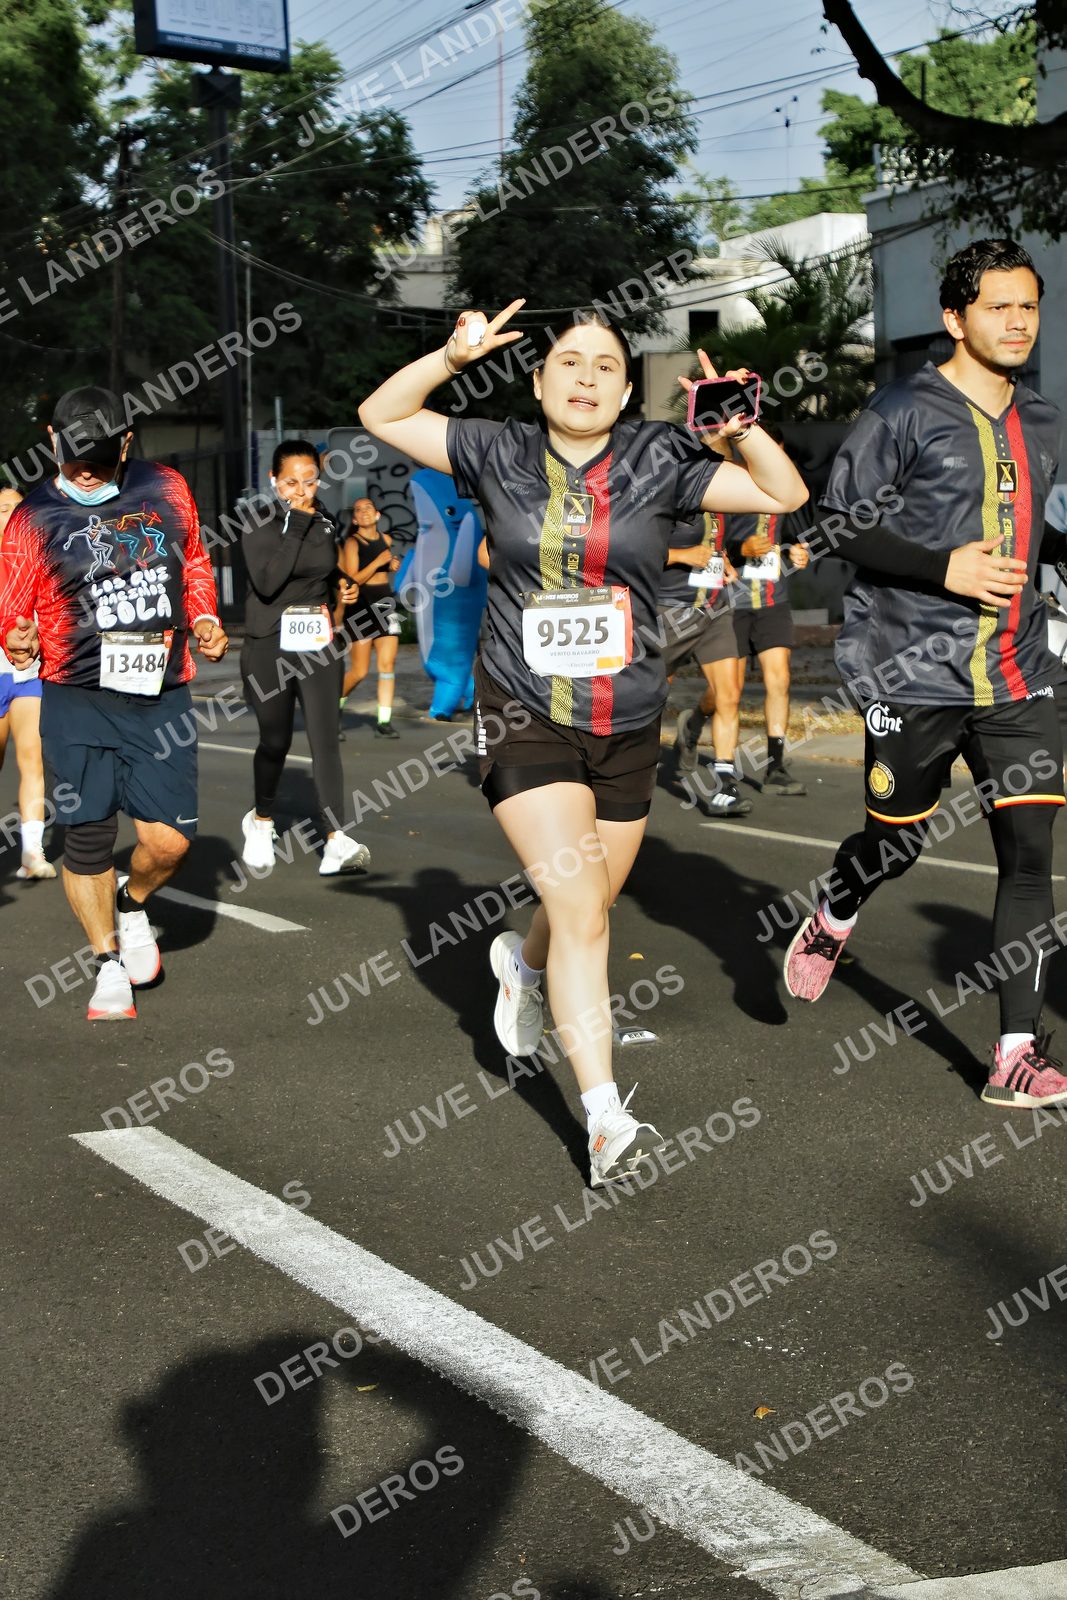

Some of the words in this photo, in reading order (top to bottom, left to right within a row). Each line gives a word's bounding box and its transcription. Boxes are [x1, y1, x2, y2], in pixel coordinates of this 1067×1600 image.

[91, 577, 126, 597] LOS
[130, 566, 168, 588] QUE
[99, 583, 166, 606] HACEMOS
[96, 594, 172, 629] BOLA
[289, 621, 322, 635] 8063
[537, 616, 609, 648] 9525
[106, 653, 165, 674] 13484
